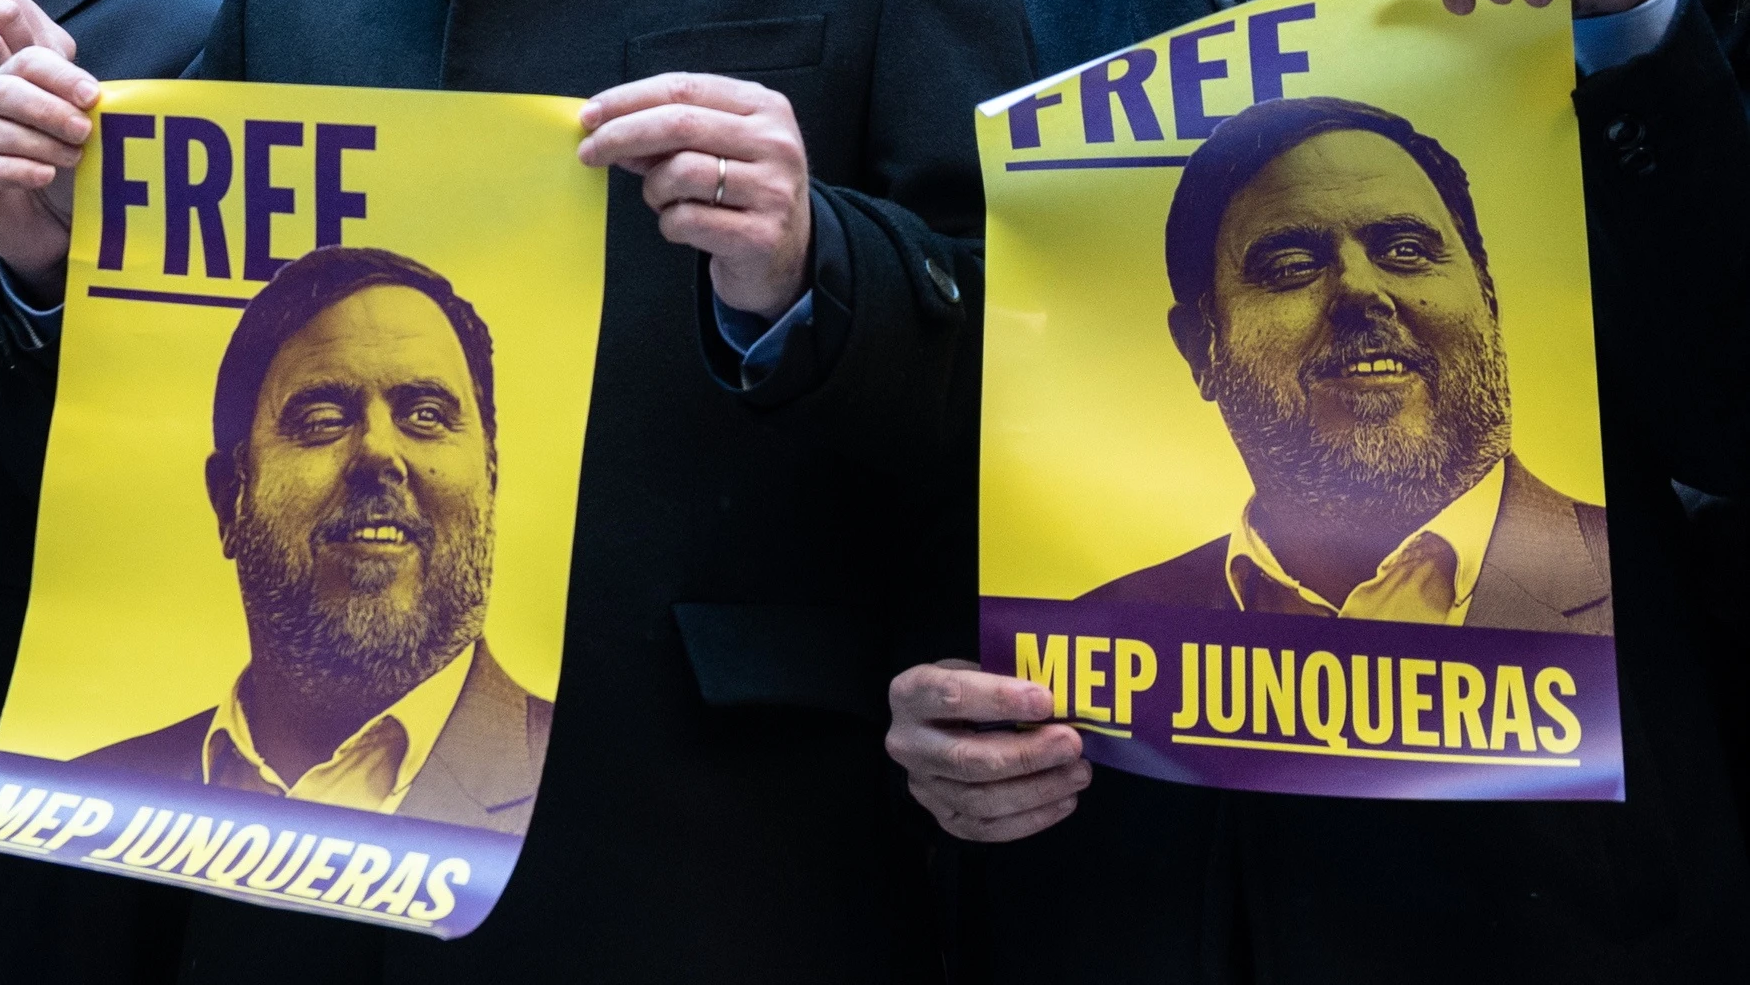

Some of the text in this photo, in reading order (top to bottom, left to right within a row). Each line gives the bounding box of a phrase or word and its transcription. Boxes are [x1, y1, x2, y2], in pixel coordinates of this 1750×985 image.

[97, 112, 377, 282] FREE
[1015, 632, 1582, 755] MEP JUNQUERAS
[89, 806, 471, 922] JUNQUERAS
